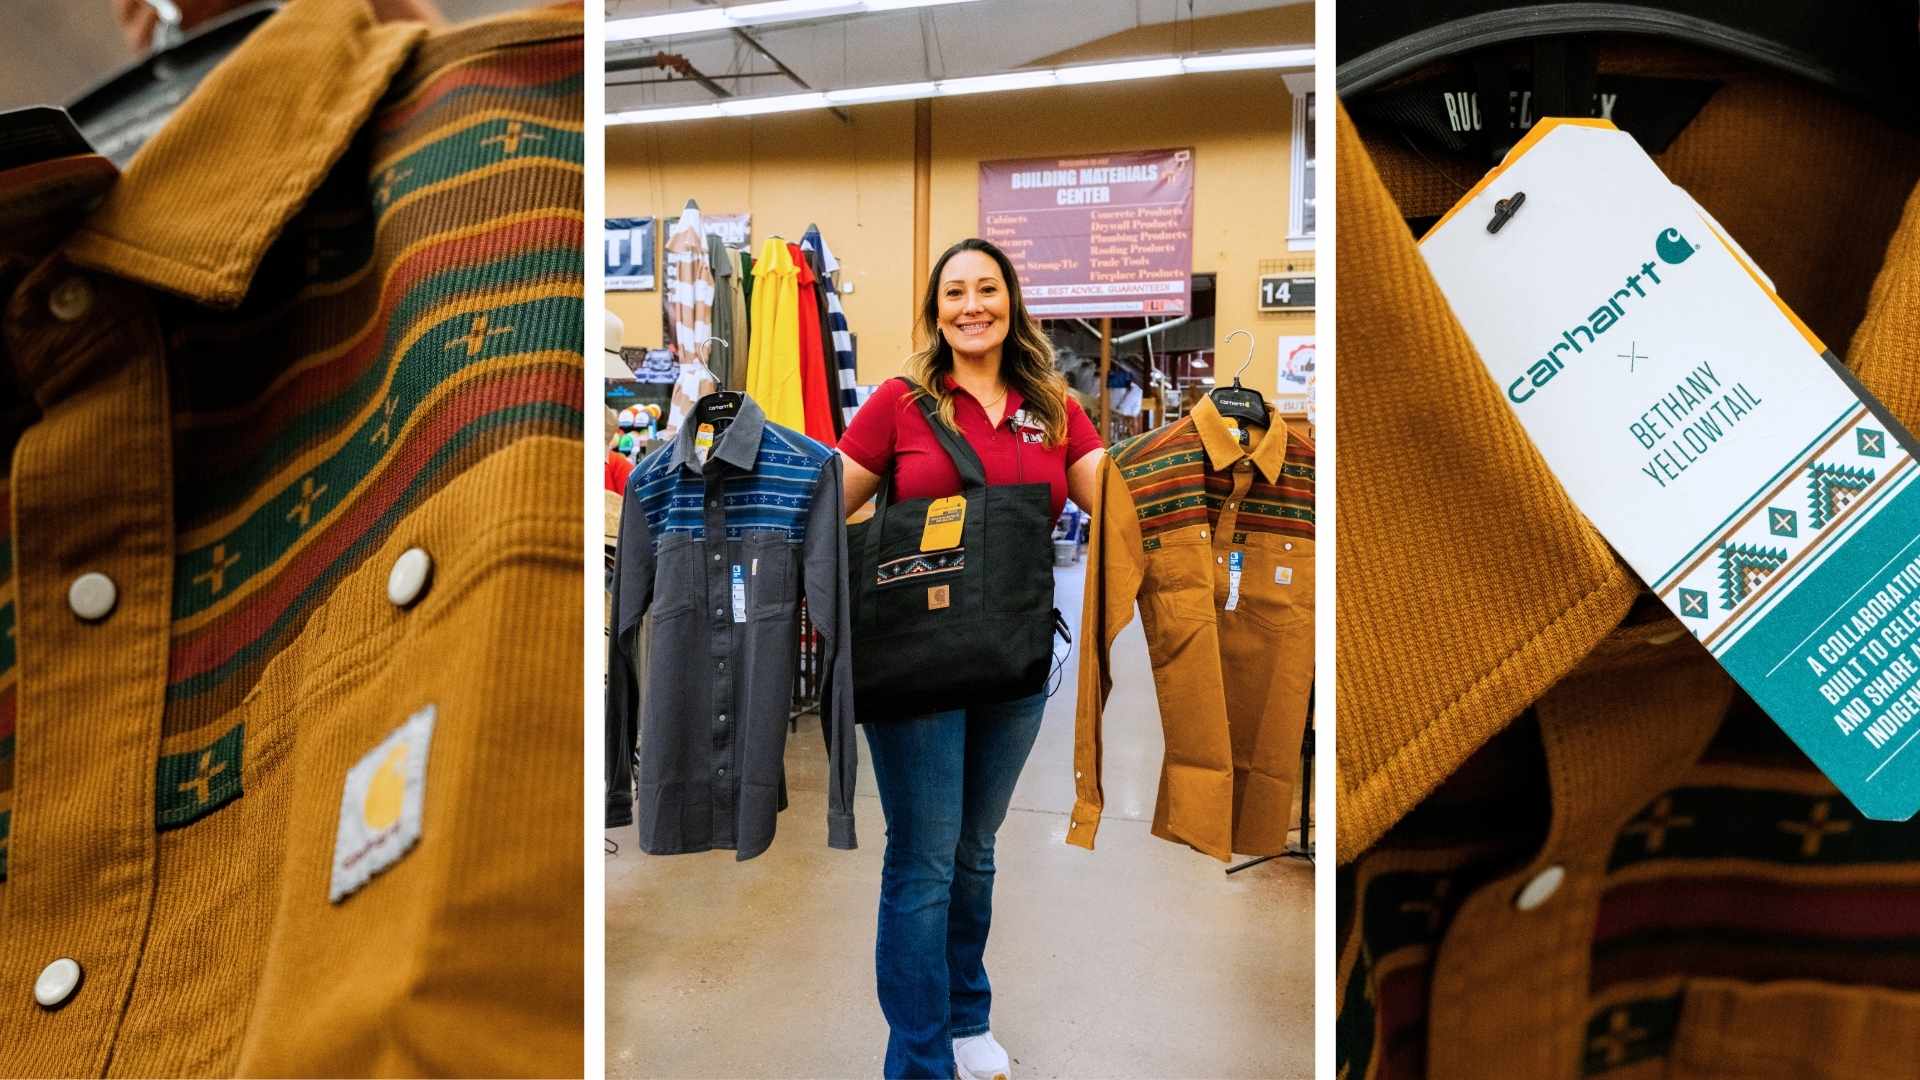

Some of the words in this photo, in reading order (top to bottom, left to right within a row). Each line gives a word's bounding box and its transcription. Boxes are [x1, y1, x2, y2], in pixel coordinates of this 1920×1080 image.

[1011, 169, 1077, 189] BUILDING
[1079, 164, 1158, 185] MATERIALS
[1056, 186, 1110, 205] CENTER
[986, 214, 1028, 225] Cabinets
[1090, 209, 1137, 220] Concrete
[1138, 207, 1184, 218] Products
[986, 226, 1016, 237] Doors
[1091, 220, 1131, 233] Drywall
[1132, 219, 1179, 230] Products
[1090, 233, 1139, 245] Plumbing
[1140, 231, 1187, 242] Products
[1130, 243, 1176, 254] Products
[1089, 257, 1121, 268] Trade
[1121, 255, 1150, 266] Tools
[1089, 270, 1137, 282] Fireplace
[1138, 268, 1185, 279] Products
[1263, 281, 1291, 304] 14
[1507, 260, 1662, 404] carhartt
[1629, 360, 1723, 452] BETHANY
[1641, 382, 1762, 488] YELLOWTAIL
[1806, 655, 1828, 678] A
[1818, 554, 1920, 664] COLLABORATIO
[1819, 656, 1868, 706] BUILT
[1859, 639, 1889, 667] TO
[1833, 697, 1872, 736] AND
[1863, 653, 1919, 707] SHARE
[1862, 679, 1920, 750] INDIGEN
